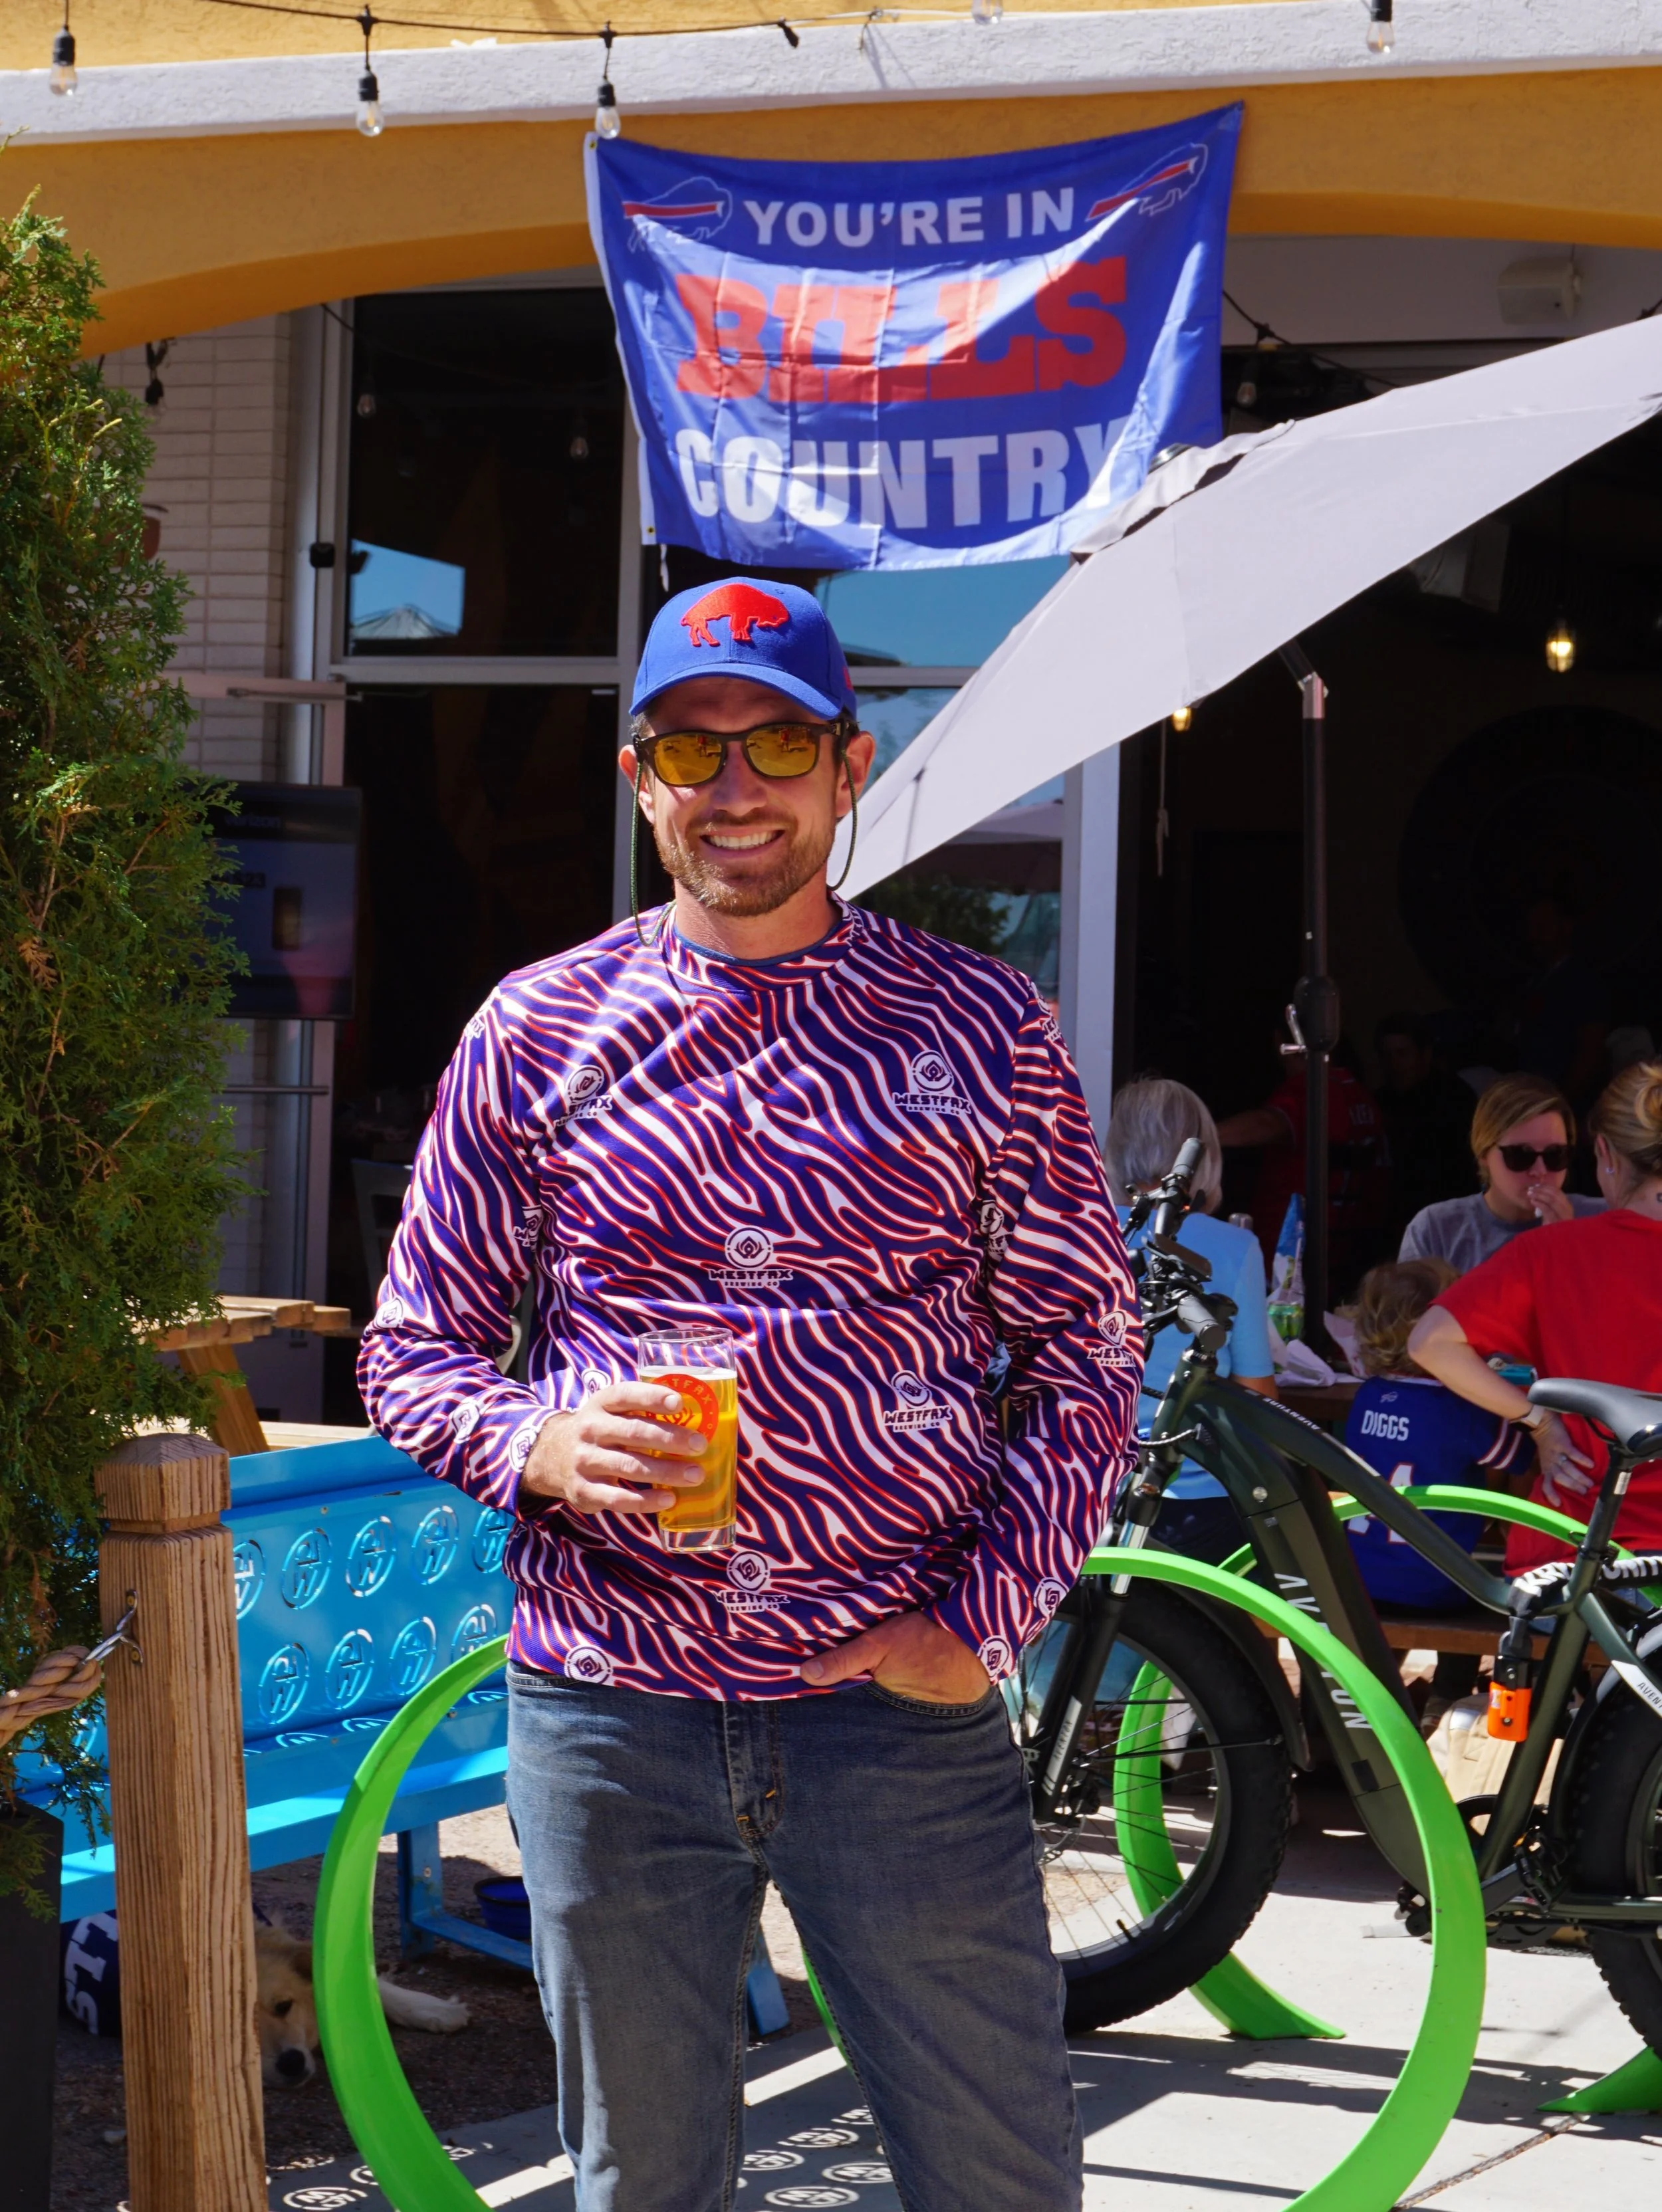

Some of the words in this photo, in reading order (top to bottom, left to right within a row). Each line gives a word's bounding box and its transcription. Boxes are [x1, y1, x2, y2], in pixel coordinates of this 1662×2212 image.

[744, 195, 985, 248] YOU'RE
[1007, 187, 1075, 238] IN
[674, 257, 1127, 405] BILLS
[674, 415, 1128, 529] COUNTRY
[894, 1094, 970, 1113] WESTFAX
[710, 1270, 791, 1279] WESTFAX
[884, 1406, 951, 1424] WESTFAX
[1361, 1410, 1410, 1442] DIGGS
